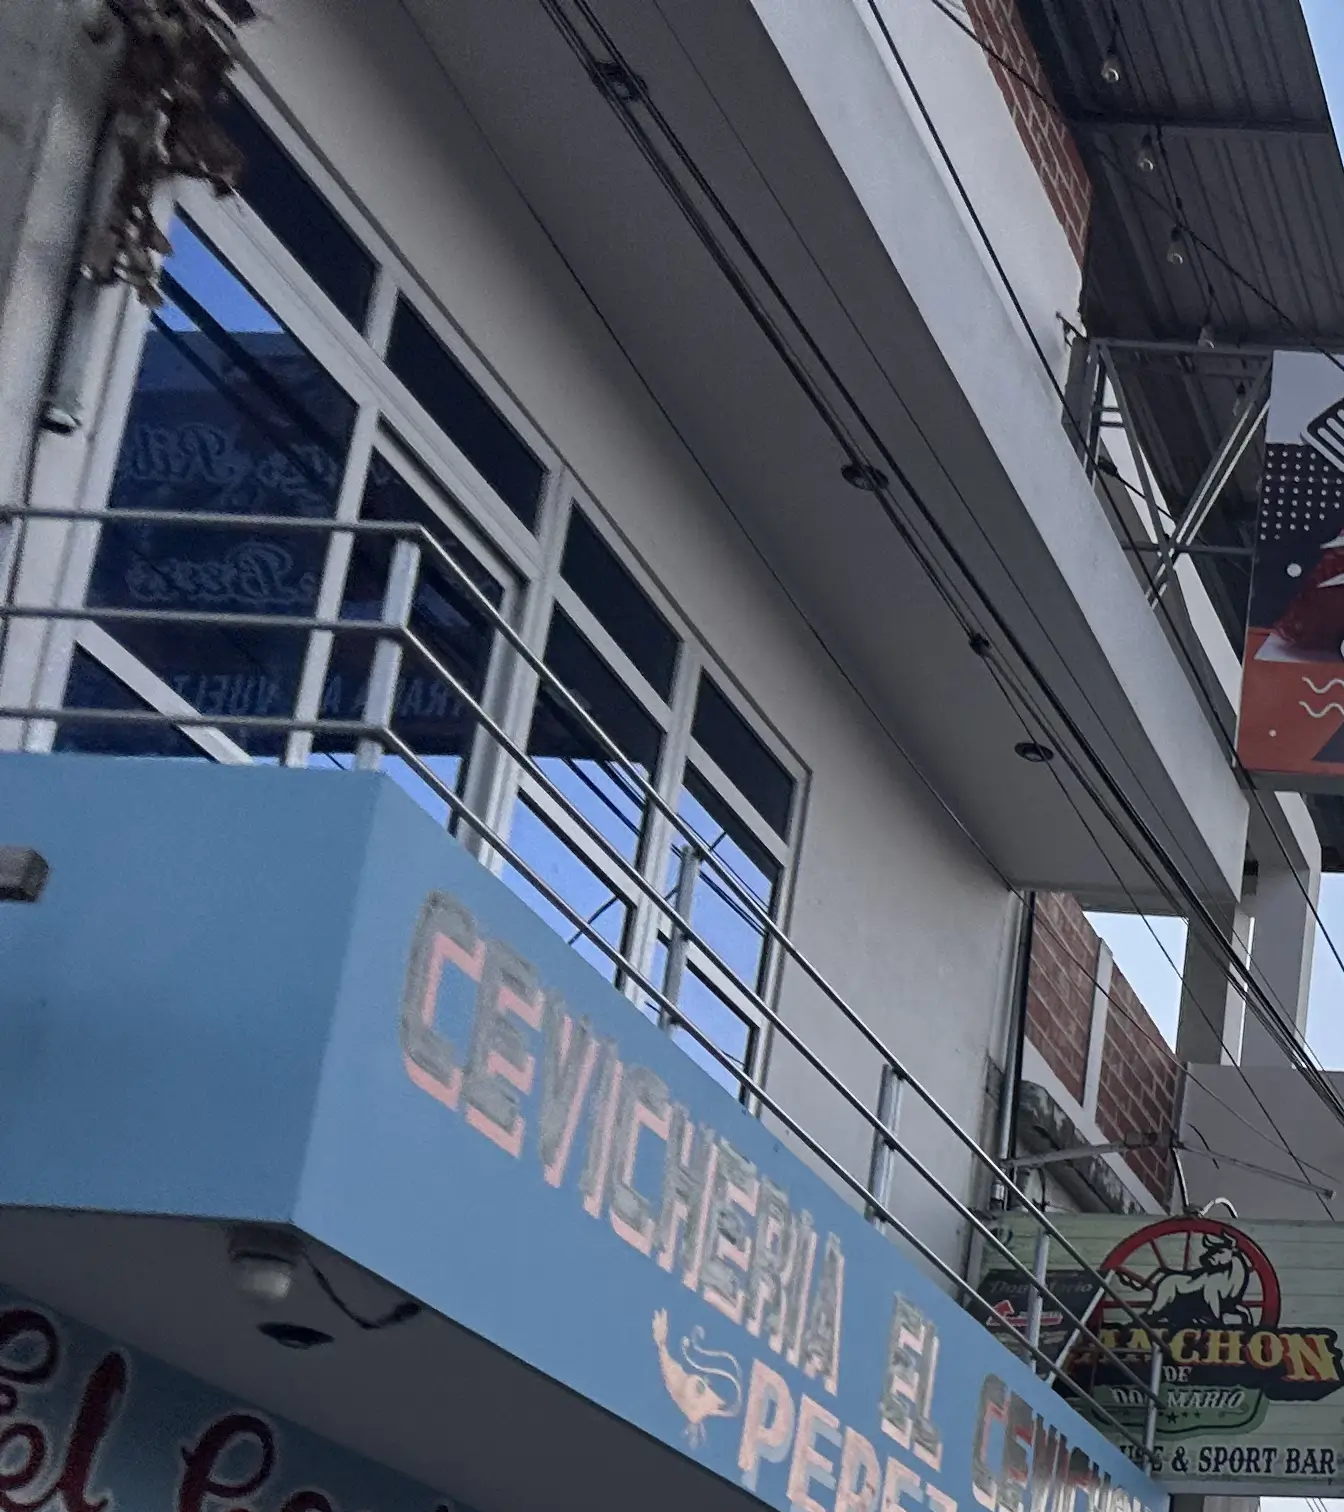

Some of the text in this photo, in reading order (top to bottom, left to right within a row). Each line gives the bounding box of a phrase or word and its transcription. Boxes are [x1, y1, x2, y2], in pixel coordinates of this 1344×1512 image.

[402, 890, 846, 1395] CEVICHERIA
[882, 1292, 942, 1471] EL
[1074, 1327, 1341, 1382] ANCHON
[1162, 1366, 1193, 1383] DE
[1110, 1386, 1247, 1409] DO MARIO
[1172, 1446, 1189, 1475] &
[1199, 1446, 1279, 1475] SPORT
[1285, 1448, 1336, 1476] BAR
